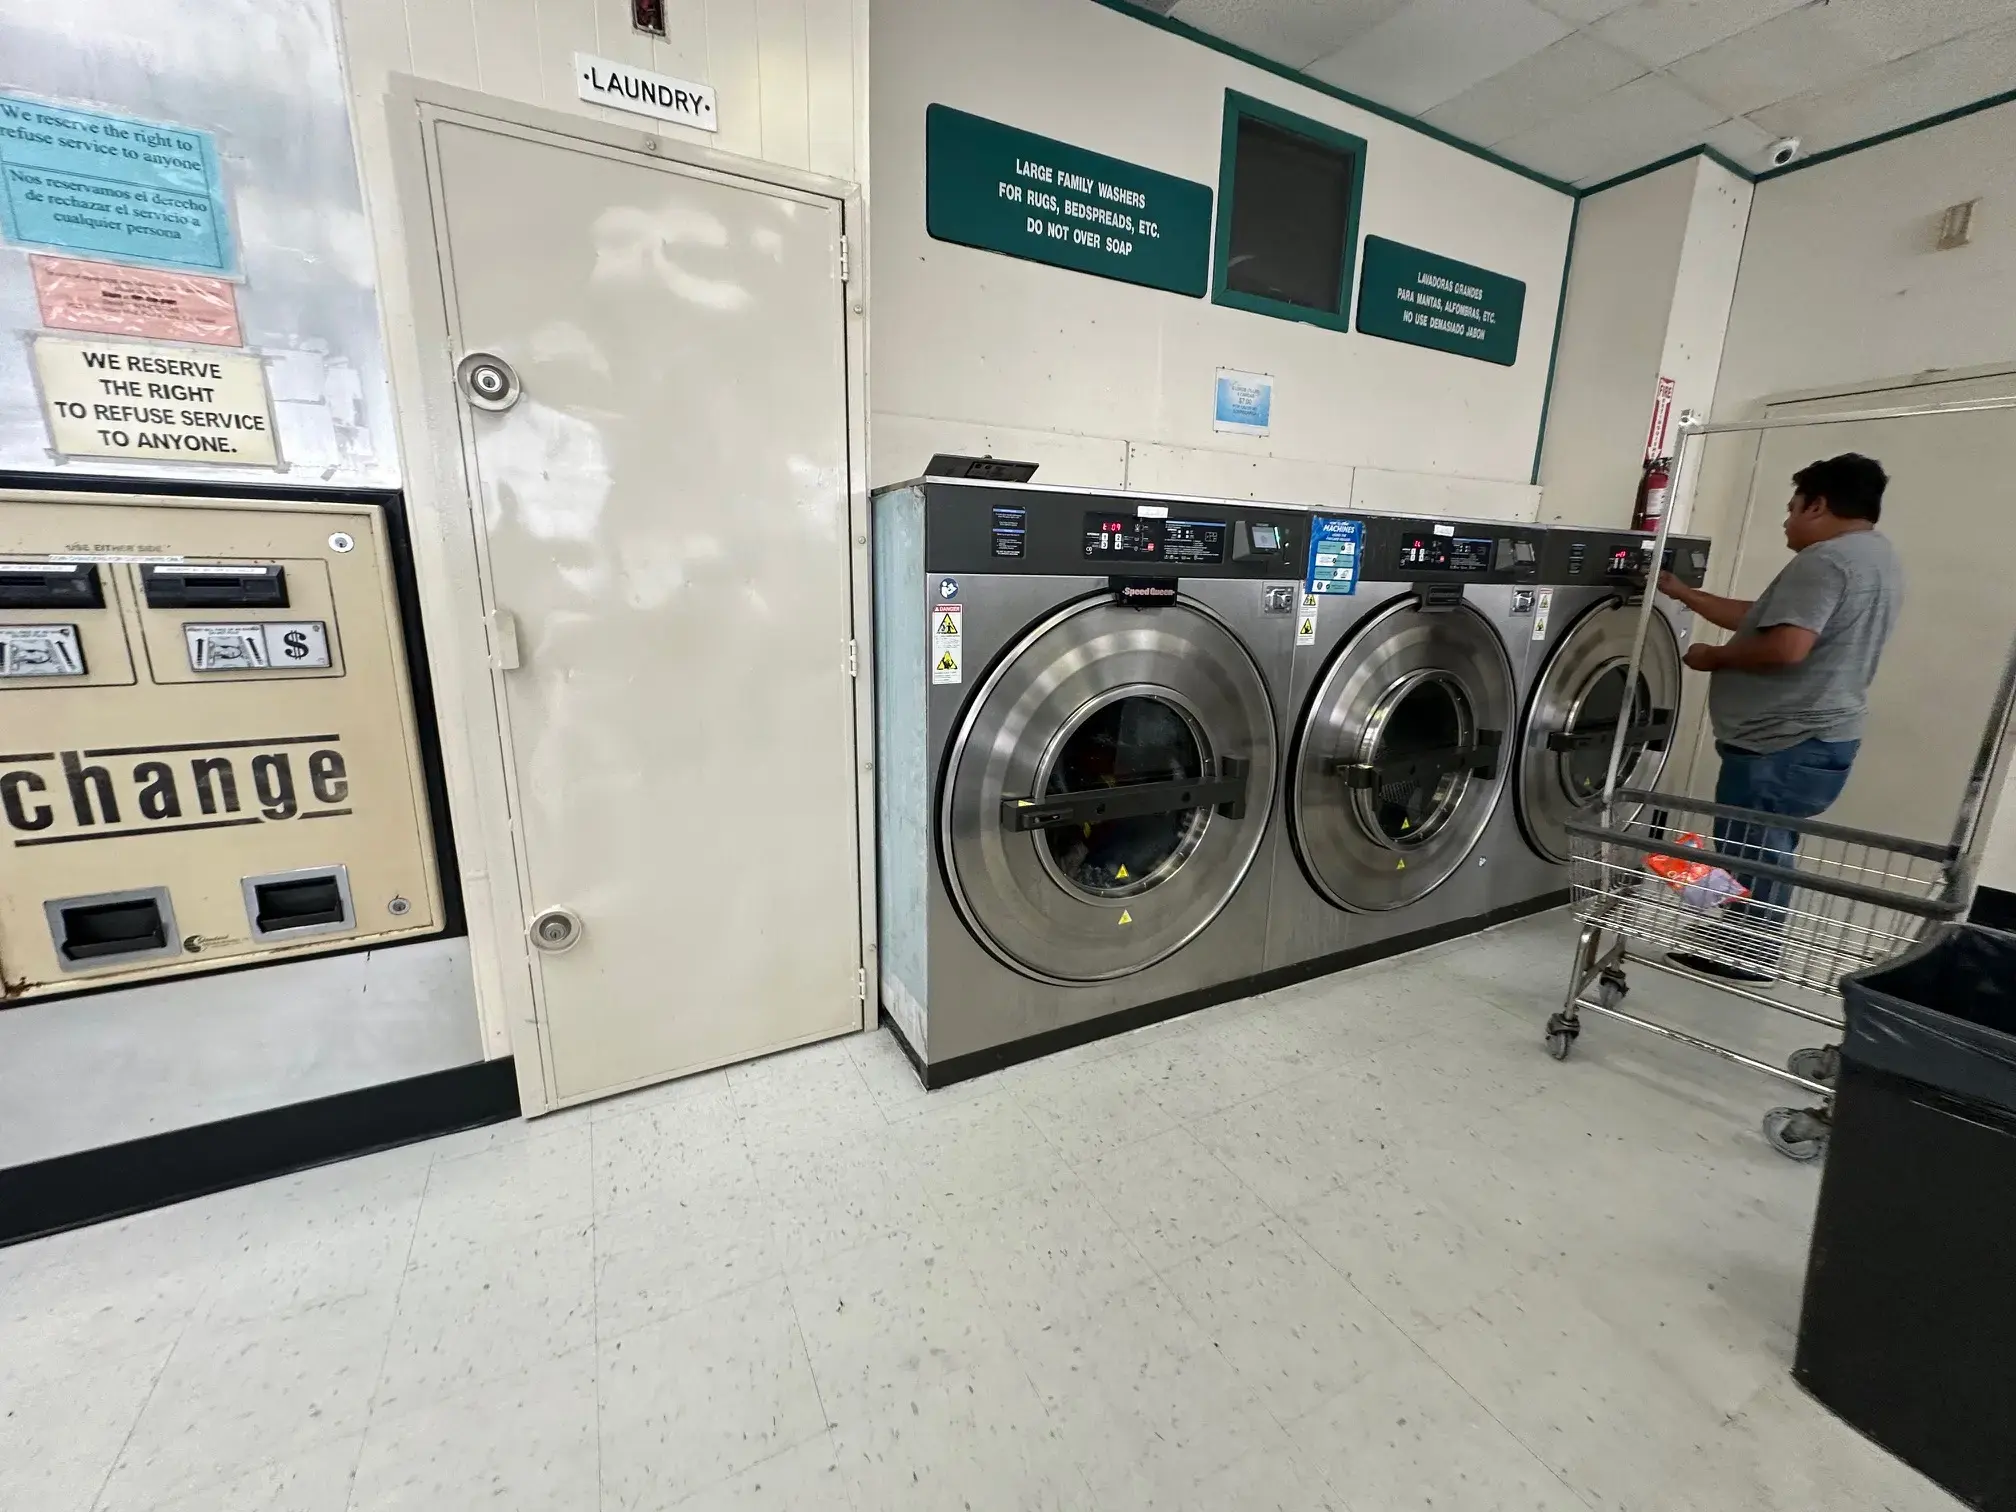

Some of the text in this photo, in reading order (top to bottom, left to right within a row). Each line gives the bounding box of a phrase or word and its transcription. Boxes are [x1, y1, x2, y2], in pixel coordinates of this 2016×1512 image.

[0, 103, 193, 151] We reserve the right to
[0, 126, 201, 171] refuse service to anyone
[10, 169, 208, 213] Nos reservamos el derecho
[1016, 158, 1146, 209] LARGE FAMILY WASHERS
[25, 189, 201, 227] de rechazar el servicio a
[999, 181, 1160, 239] FOR RUGS, BEDSPREADS, ETC.
[54, 211, 182, 240] cualquier persona
[1027, 216, 1133, 256] DO NOT OVER SOAP
[1417, 272, 1483, 301] LAVADORAS GRANDES
[1397, 287, 1497, 324] PARA MANTAS, ALFOMBRAS, ETC.
[1402, 309, 1486, 341] NO USE DEMASIADO JABON
[83, 351, 222, 379] WE RESERVE
[99, 378, 214, 403] THE RIGHT
[54, 401, 265, 431] TO REFUSE SERVICE
[98, 429, 238, 453] TO ANYONE.
[1323, 524, 1355, 534] MACHINES
[1124, 586, 1174, 597] Speed Queen
[0, 750, 349, 831] change
